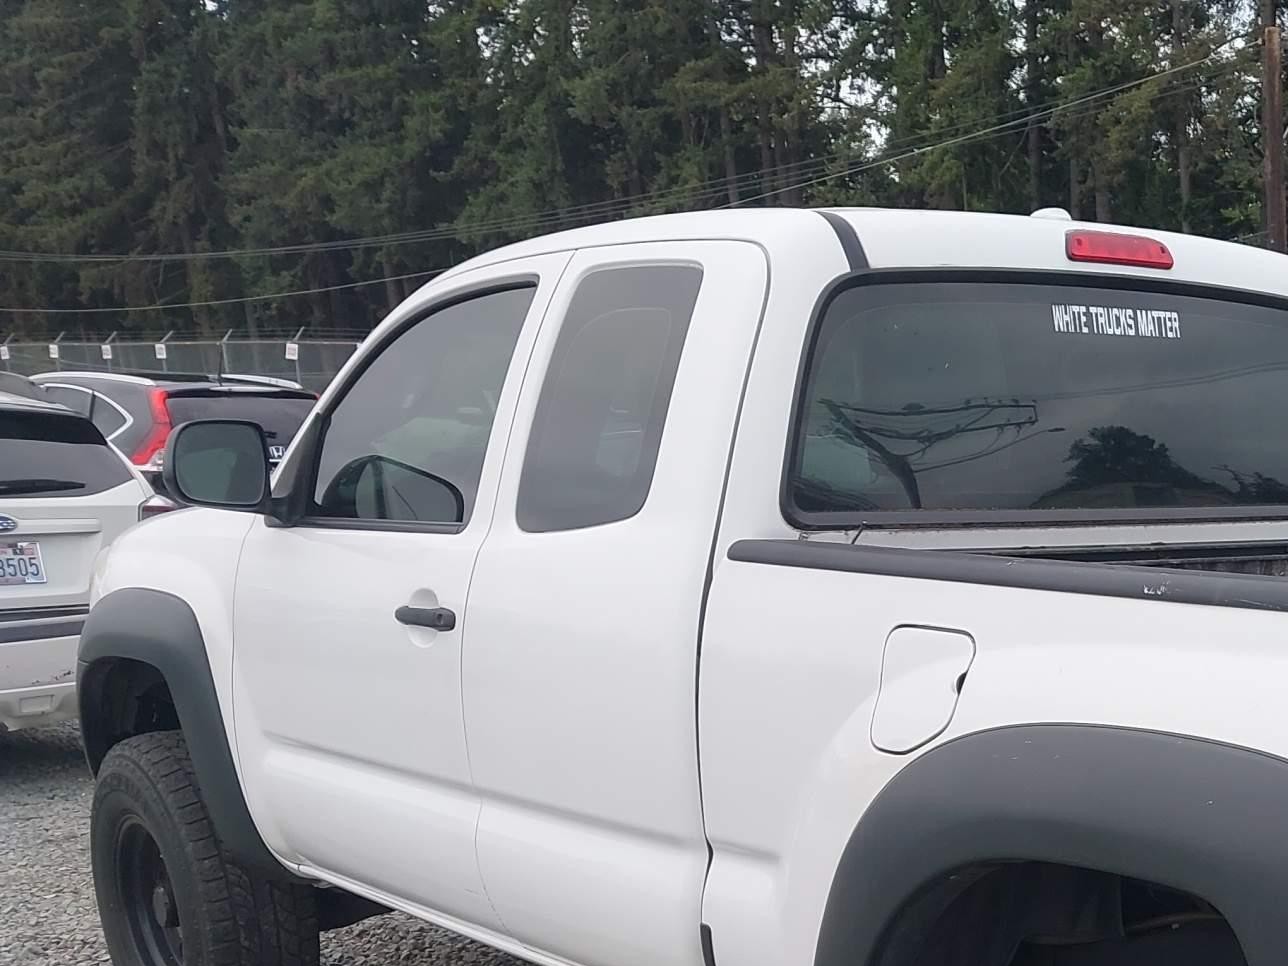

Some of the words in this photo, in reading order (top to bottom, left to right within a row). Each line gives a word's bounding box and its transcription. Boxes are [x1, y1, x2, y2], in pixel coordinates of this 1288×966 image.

[1051, 304, 1089, 334] WHITE
[1089, 306, 1136, 336] TRUCKS
[1136, 309, 1181, 338] MATTER
